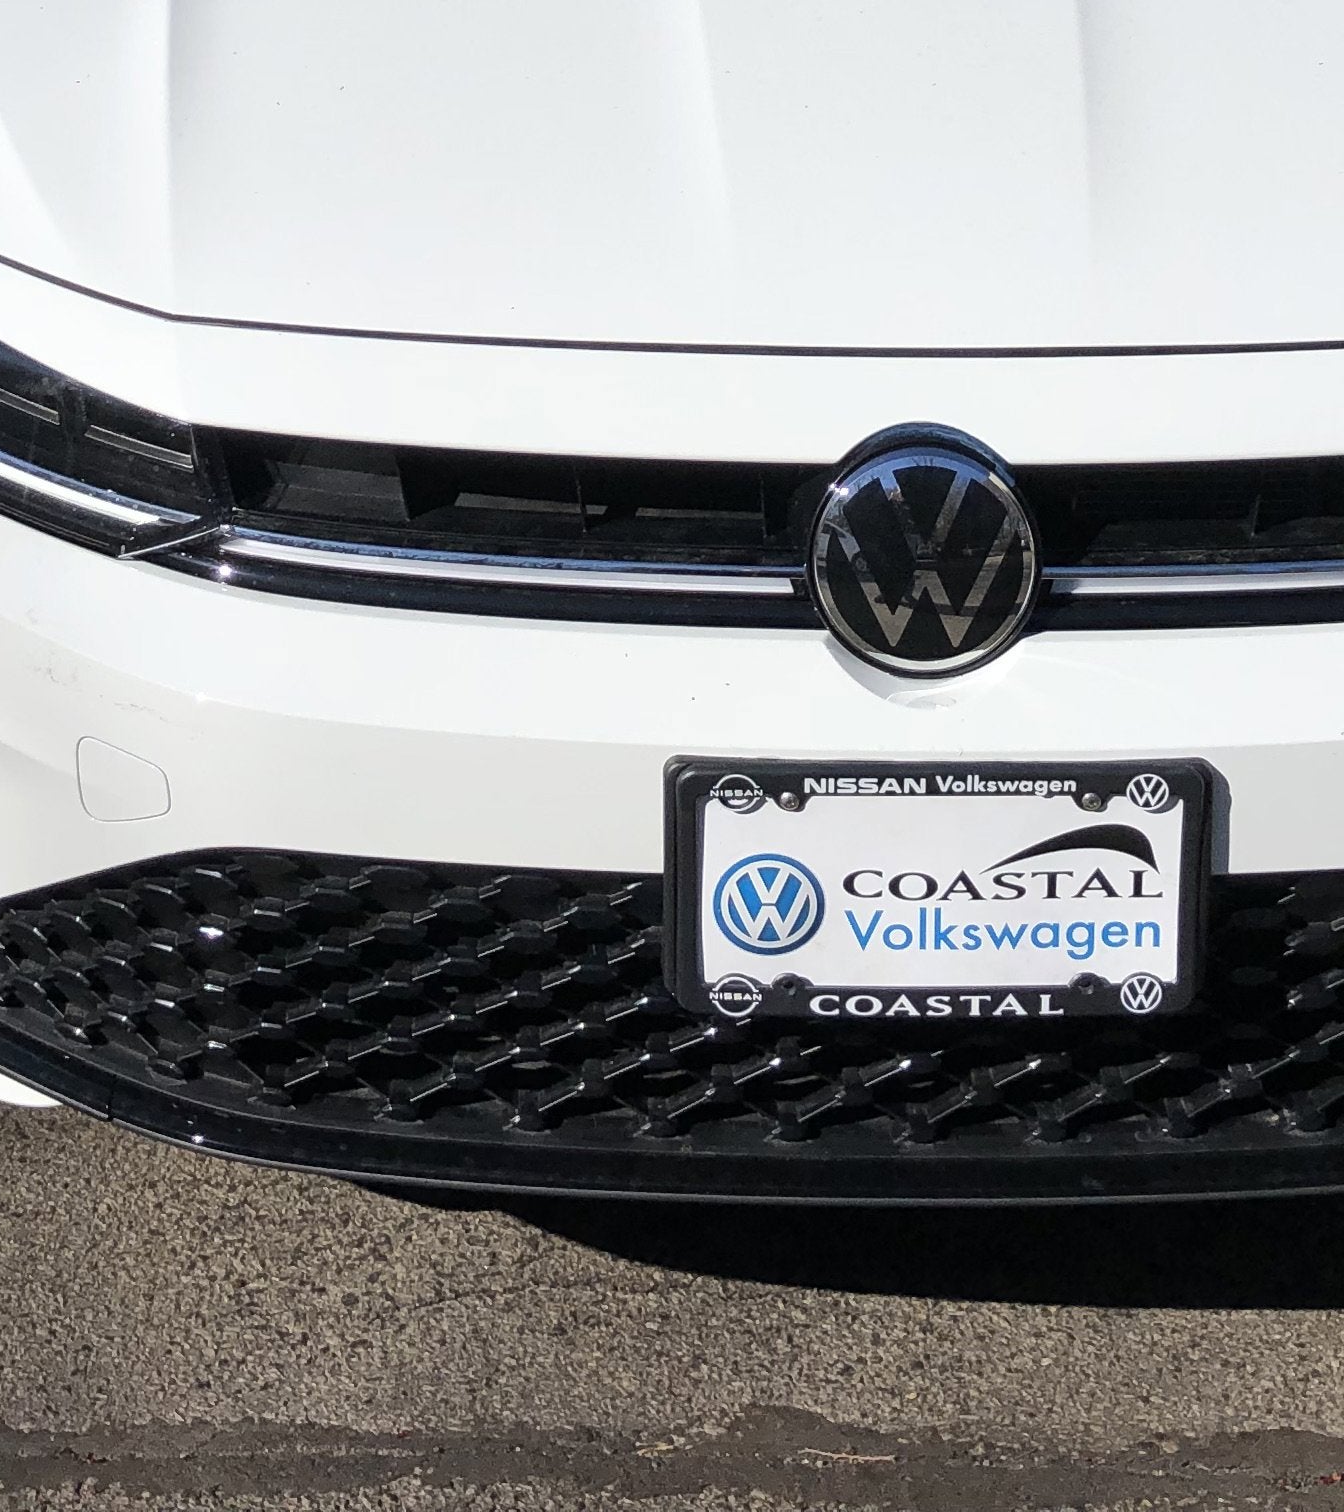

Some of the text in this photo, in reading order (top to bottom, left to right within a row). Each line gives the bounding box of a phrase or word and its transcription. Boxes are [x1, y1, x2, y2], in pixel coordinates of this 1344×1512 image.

[709, 787, 764, 798] NISSAN
[803, 774, 1078, 796] NISSAN Volkswagen
[842, 868, 1164, 901] COASTAL
[843, 907, 1162, 960] Volkswagen
[708, 991, 763, 1003] NISSAN
[808, 994, 1065, 1017] COASTAL
